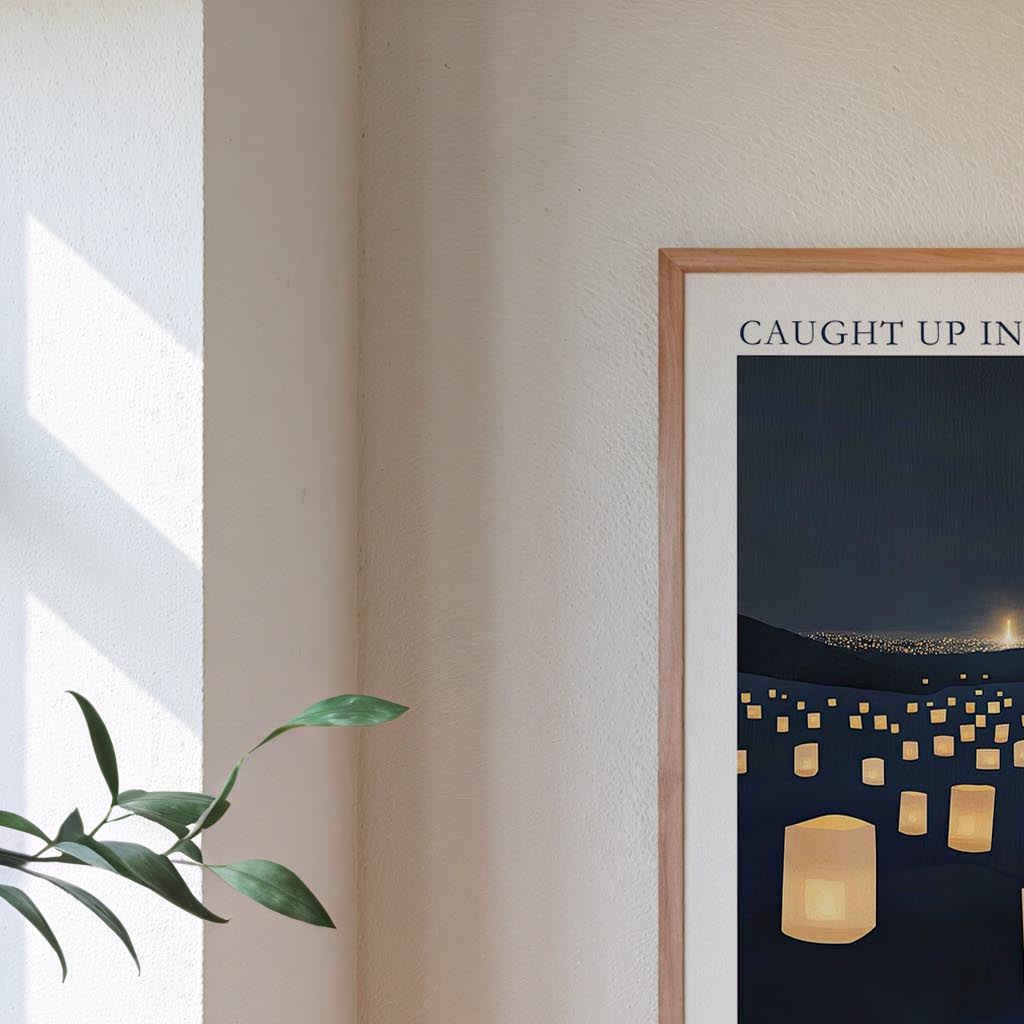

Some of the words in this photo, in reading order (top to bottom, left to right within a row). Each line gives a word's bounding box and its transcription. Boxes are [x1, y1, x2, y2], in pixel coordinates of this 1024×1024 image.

[740, 320, 903, 345] CAUGHT
[917, 321, 965, 345] UP
[981, 321, 1022, 345] IN
